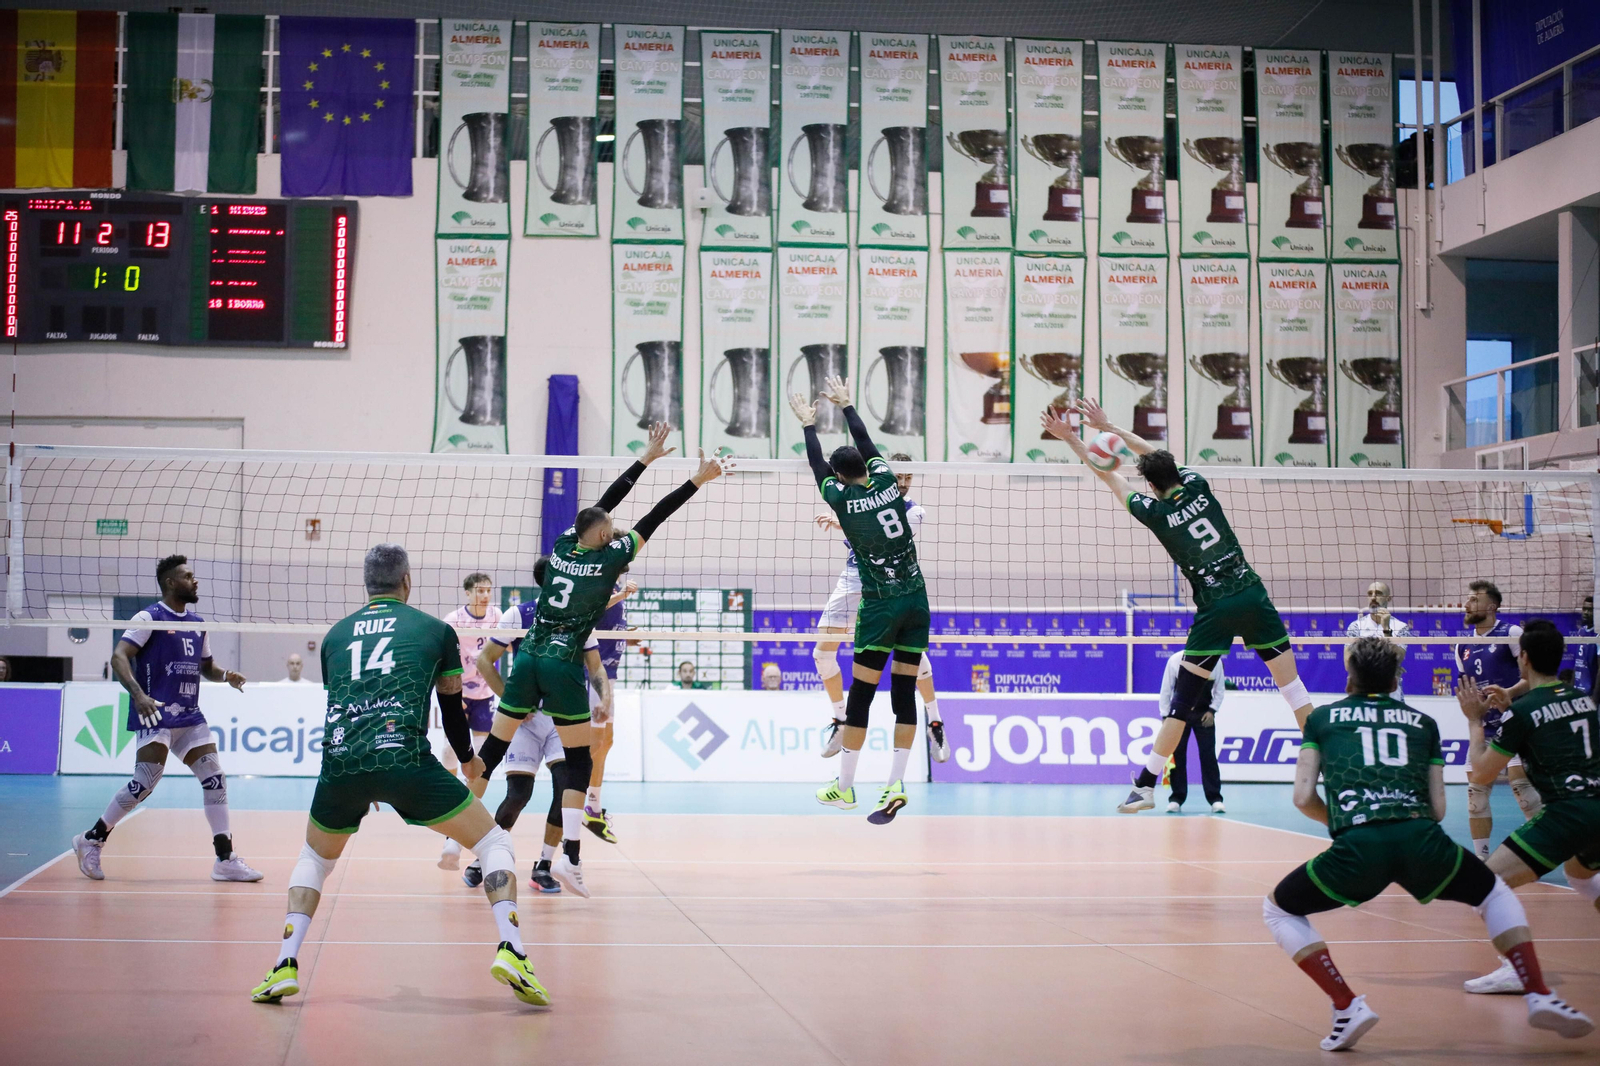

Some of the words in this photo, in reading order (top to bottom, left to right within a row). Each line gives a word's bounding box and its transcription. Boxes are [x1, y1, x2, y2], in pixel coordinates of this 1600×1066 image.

[454, 23, 499, 32] UNICAJA
[542, 28, 587, 37] UNICAJA
[627, 30, 671, 39] UNICAJA
[714, 39, 759, 48] UNICAJA
[793, 35, 838, 44] UNICAJA
[872, 38, 917, 47] UNICAJA
[951, 41, 994, 50] UNICAJA
[1027, 46, 1071, 55] UNICAJA
[1110, 47, 1154, 56] UNICAJA
[1187, 50, 1230, 59] UNICAJA
[446, 52, 506, 65] CAMPEÓN
[1267, 55, 1309, 63] UNICAJA
[1340, 56, 1382, 65] UNICAJA
[200, 205, 207, 214] E
[5, 211, 18, 220] 25
[471, 219, 496, 227] Unicaja
[58, 222, 81, 245] 11
[97, 223, 112, 244] 2
[146, 222, 170, 247] 13
[734, 232, 759, 240] Unicaja
[810, 228, 835, 237] Unicaja
[1047, 237, 1071, 245] Unicaja
[1131, 239, 1155, 247] Unicaja
[1211, 239, 1236, 247] Unicaja
[450, 246, 495, 254] UNICAJA
[626, 251, 671, 259] UNICAJA
[790, 254, 835, 263] UNICAJA
[713, 258, 758, 266] UNICAJA
[871, 256, 915, 265] UNICAJA
[957, 257, 1000, 265] UNICAJA
[1027, 263, 1071, 271] UNICAJA
[1111, 263, 1155, 271] UNICAJA
[1193, 264, 1236, 272] UNICAJA
[1271, 269, 1314, 277] UNICAJA
[1344, 270, 1387, 278] UNICAJA
[124, 266, 140, 291] 0
[442, 276, 502, 287] CAMPEÓN
[617, 280, 678, 292] CAMPEÓN
[1166, 494, 1209, 528] NEAVES
[876, 508, 904, 539] 8
[1188, 518, 1221, 551] 9
[548, 576, 574, 609] 3
[644, 590, 694, 600] VOLEIBOL
[353, 618, 396, 636] RUIZ
[182, 638, 194, 656] 15
[346, 637, 396, 680] 14
[1474, 659, 1482, 675] 3
[782, 672, 822, 681] DIPUTAC
[995, 672, 1061, 685] DIPUTACIÓN
[1329, 707, 1377, 723] FRAN
[1383, 709, 1423, 728] RUIZ
[1530, 700, 1574, 728] PAULO
[1570, 719, 1593, 759] 7
[1355, 726, 1408, 766] 10
